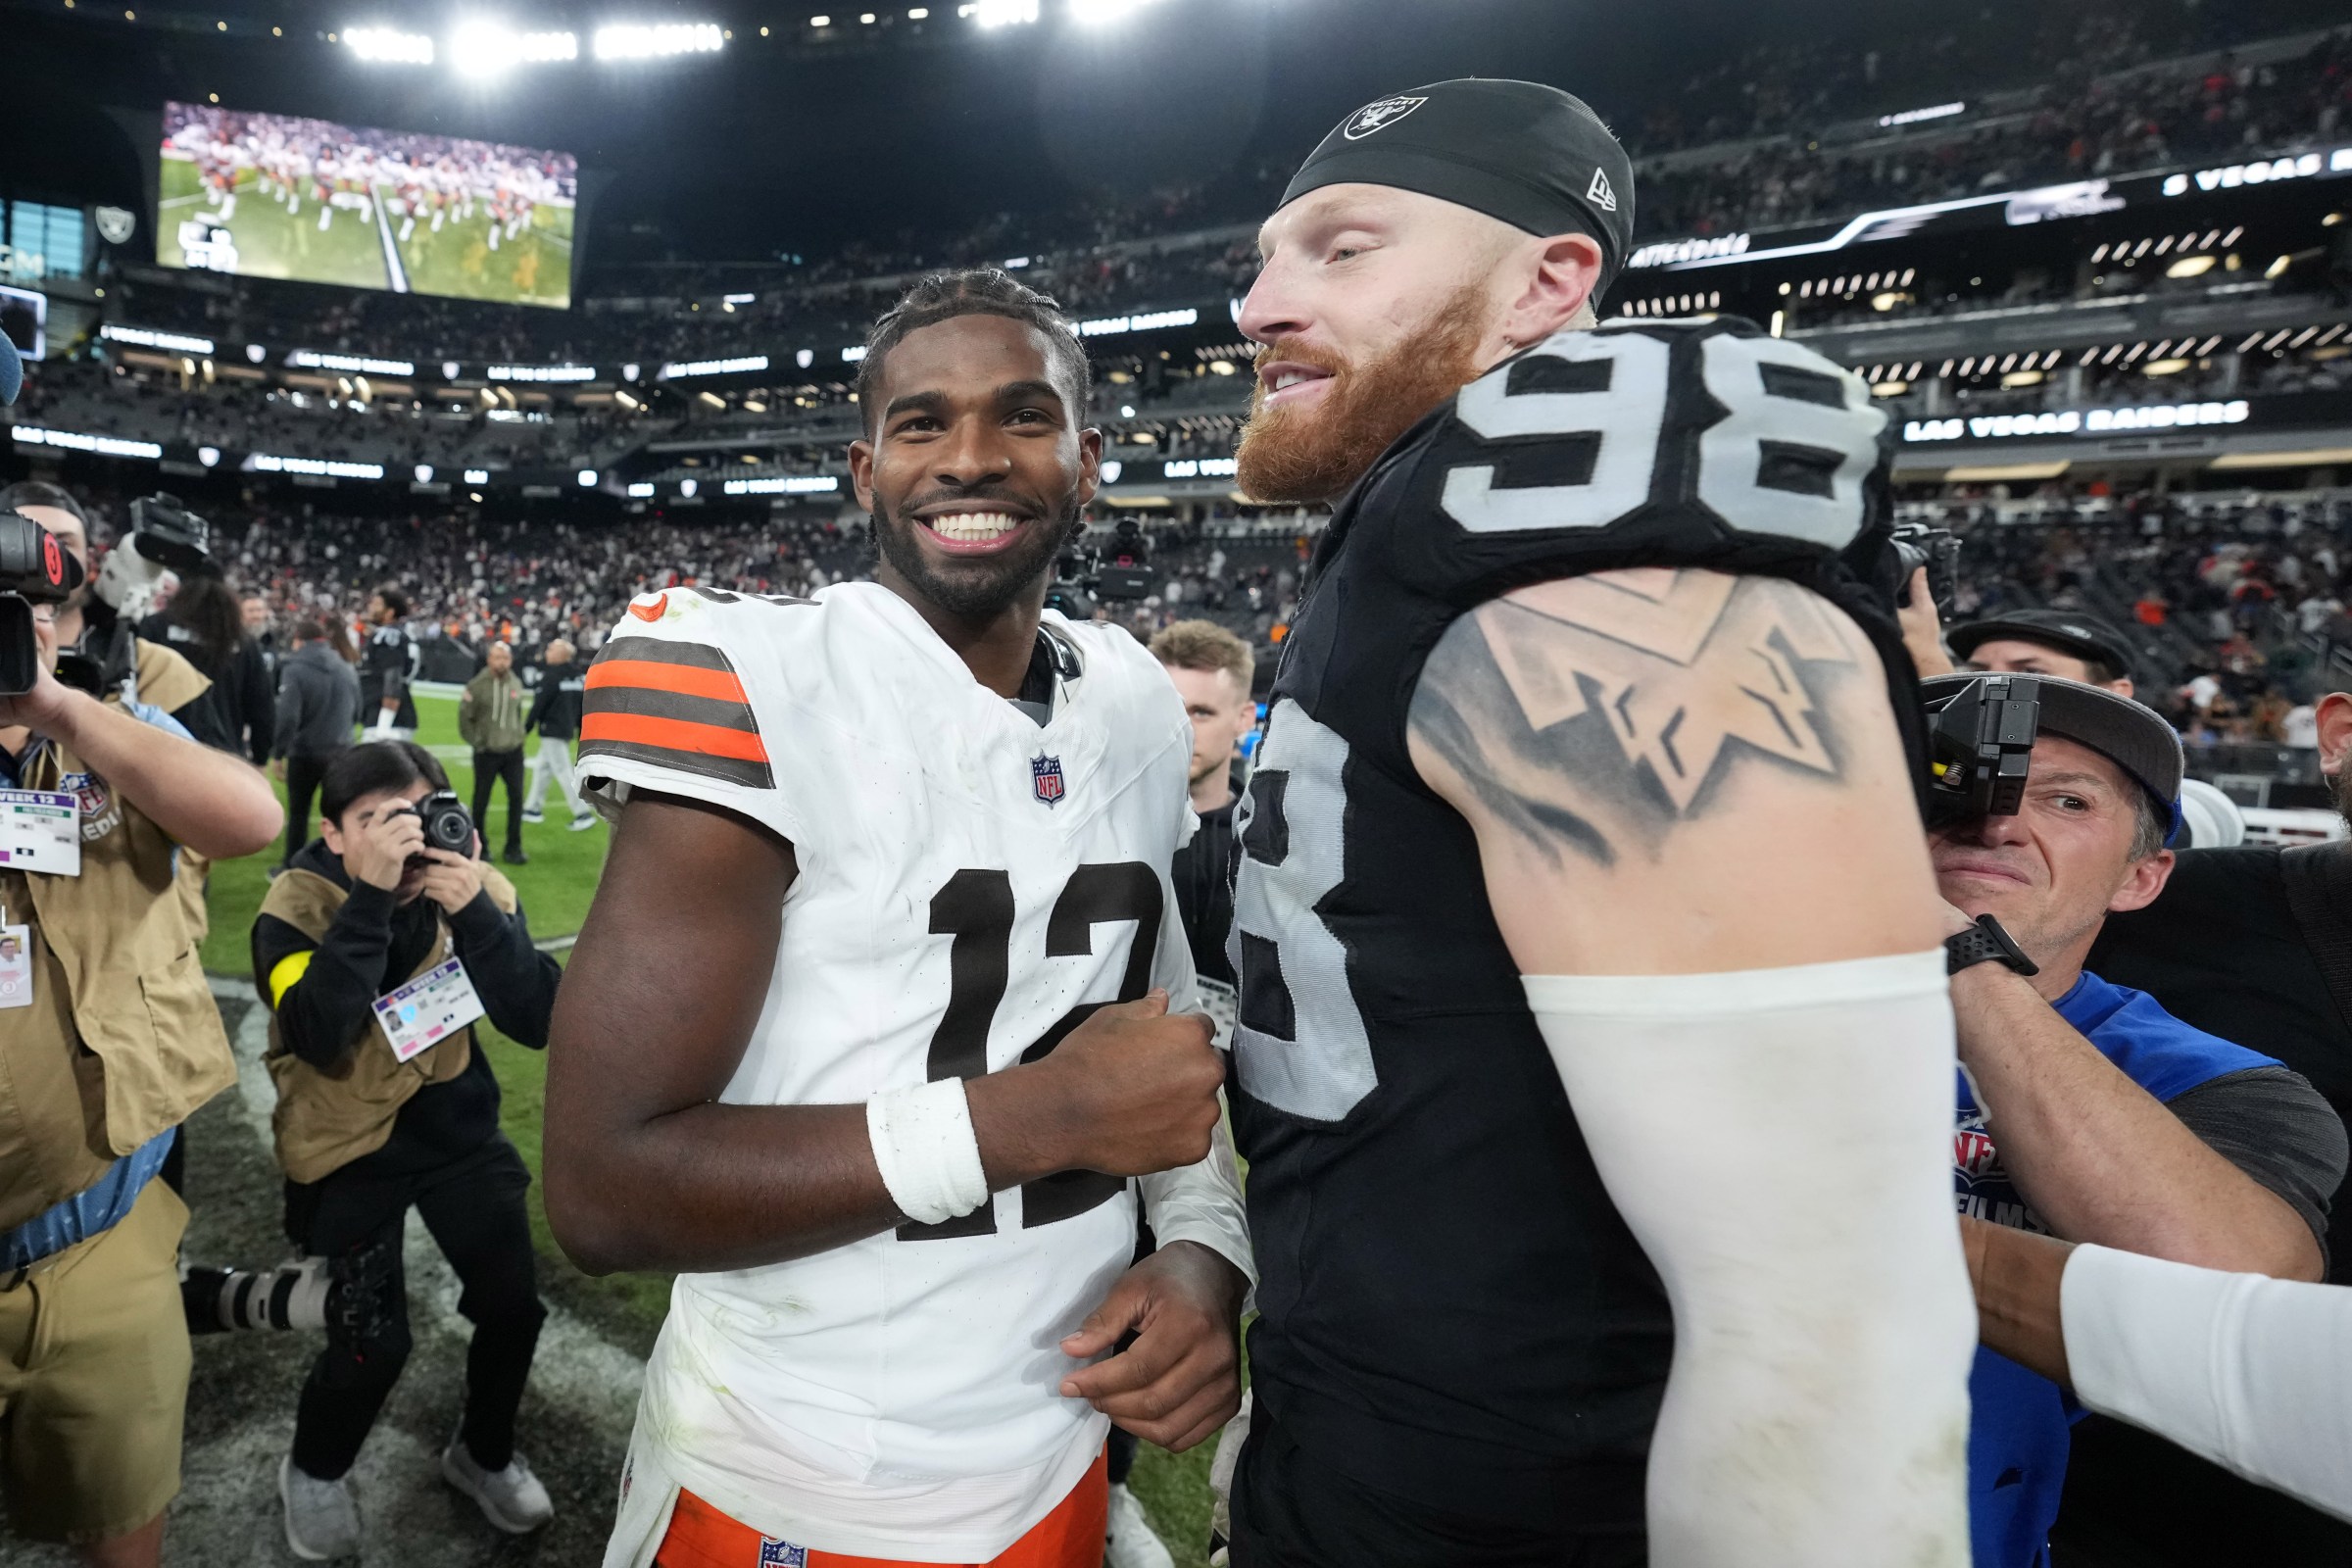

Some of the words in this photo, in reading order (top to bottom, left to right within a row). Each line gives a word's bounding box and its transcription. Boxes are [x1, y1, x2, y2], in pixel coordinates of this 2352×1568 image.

[2196, 153, 2322, 190] VEGAS
[1627, 232, 1750, 269] ATTENDING
[1904, 418, 1964, 441] LAS
[1970, 411, 2081, 437] VEGAS
[2086, 401, 2249, 431] RAIDERS
[1440, 330, 1888, 550] 98
[77, 787, 104, 811] FL
[1038, 775, 1062, 799] NFL
[80, 806, 122, 841] EDI
[896, 860, 1164, 1242] 12
[1954, 1131, 2006, 1175] NF
